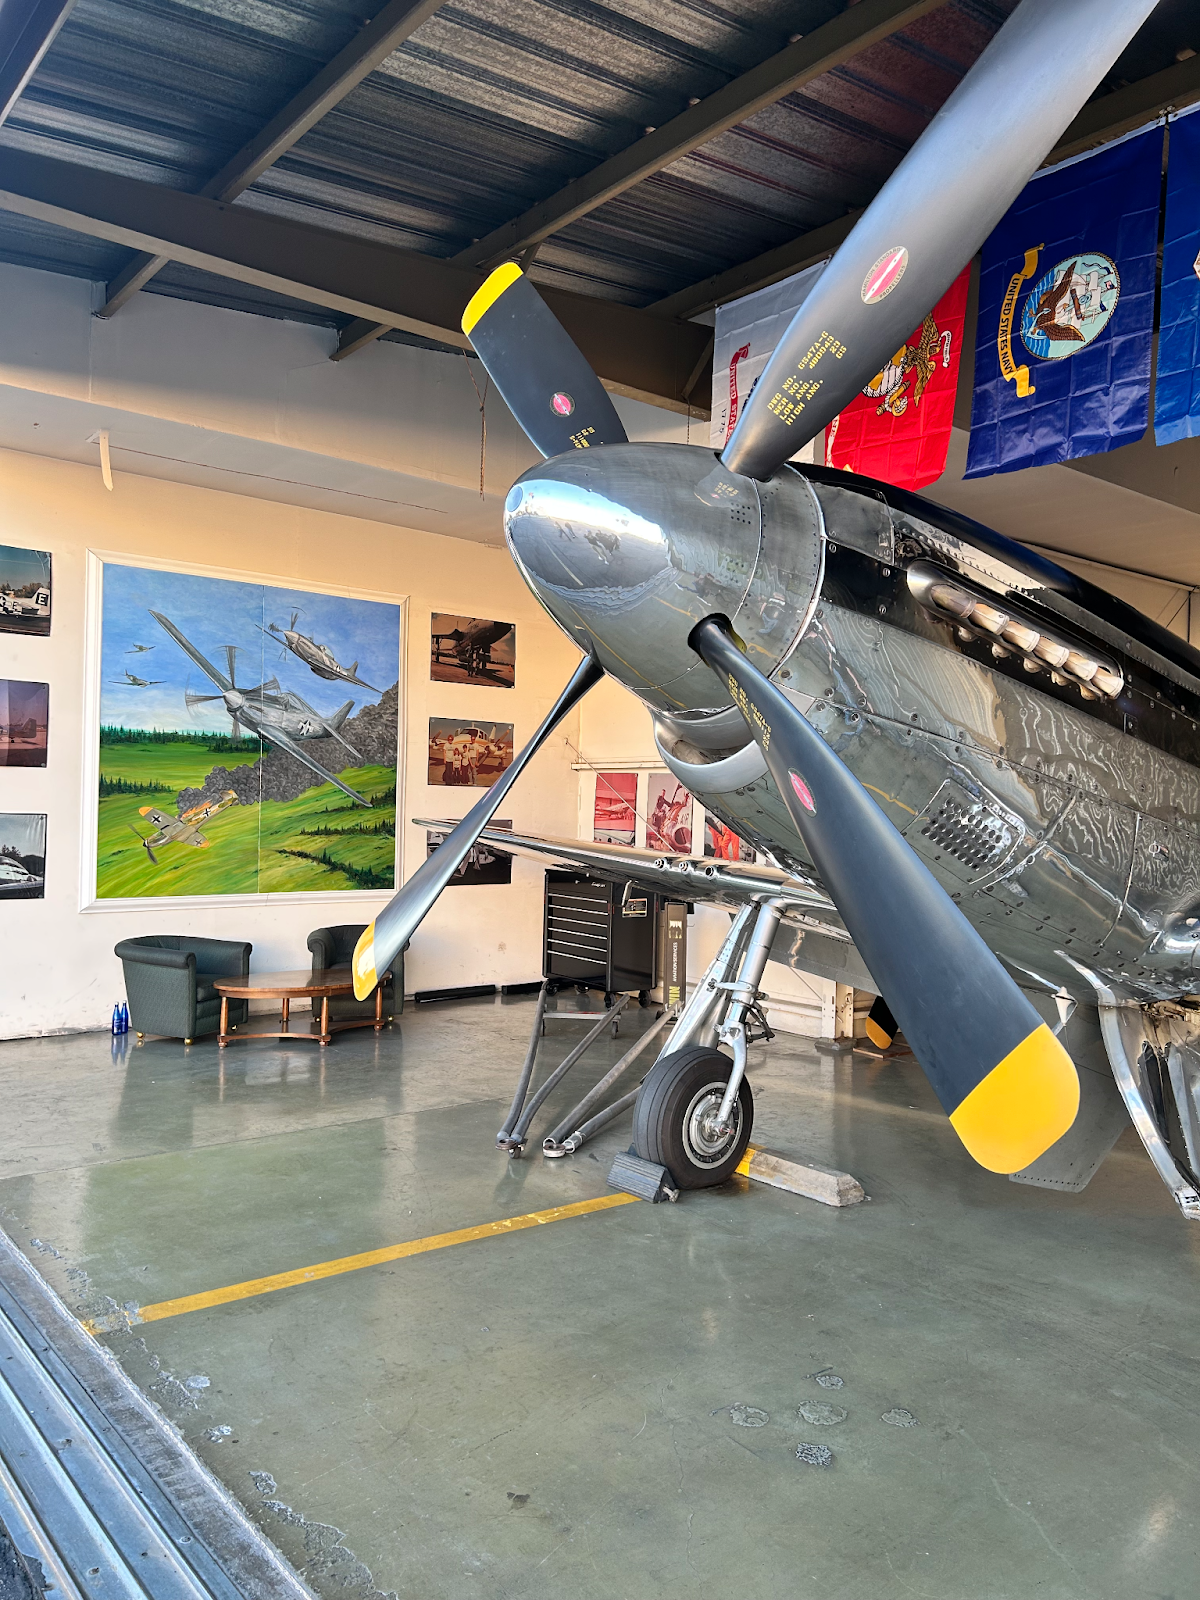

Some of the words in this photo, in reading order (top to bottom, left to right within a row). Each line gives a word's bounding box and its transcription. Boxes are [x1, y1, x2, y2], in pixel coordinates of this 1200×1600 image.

[1002, 277, 1020, 315] UNITED
[999, 318, 1010, 350] STATES
[1000, 351, 1014, 375] NAVY
[773, 397, 789, 415] SER
[788, 380, 803, 396] NO.
[779, 402, 795, 421] LOW
[795, 380, 814, 400] ANG.
[782, 375, 797, 391] NO.
[785, 402, 806, 426] HIGH
[805, 380, 824, 401] ANG.
